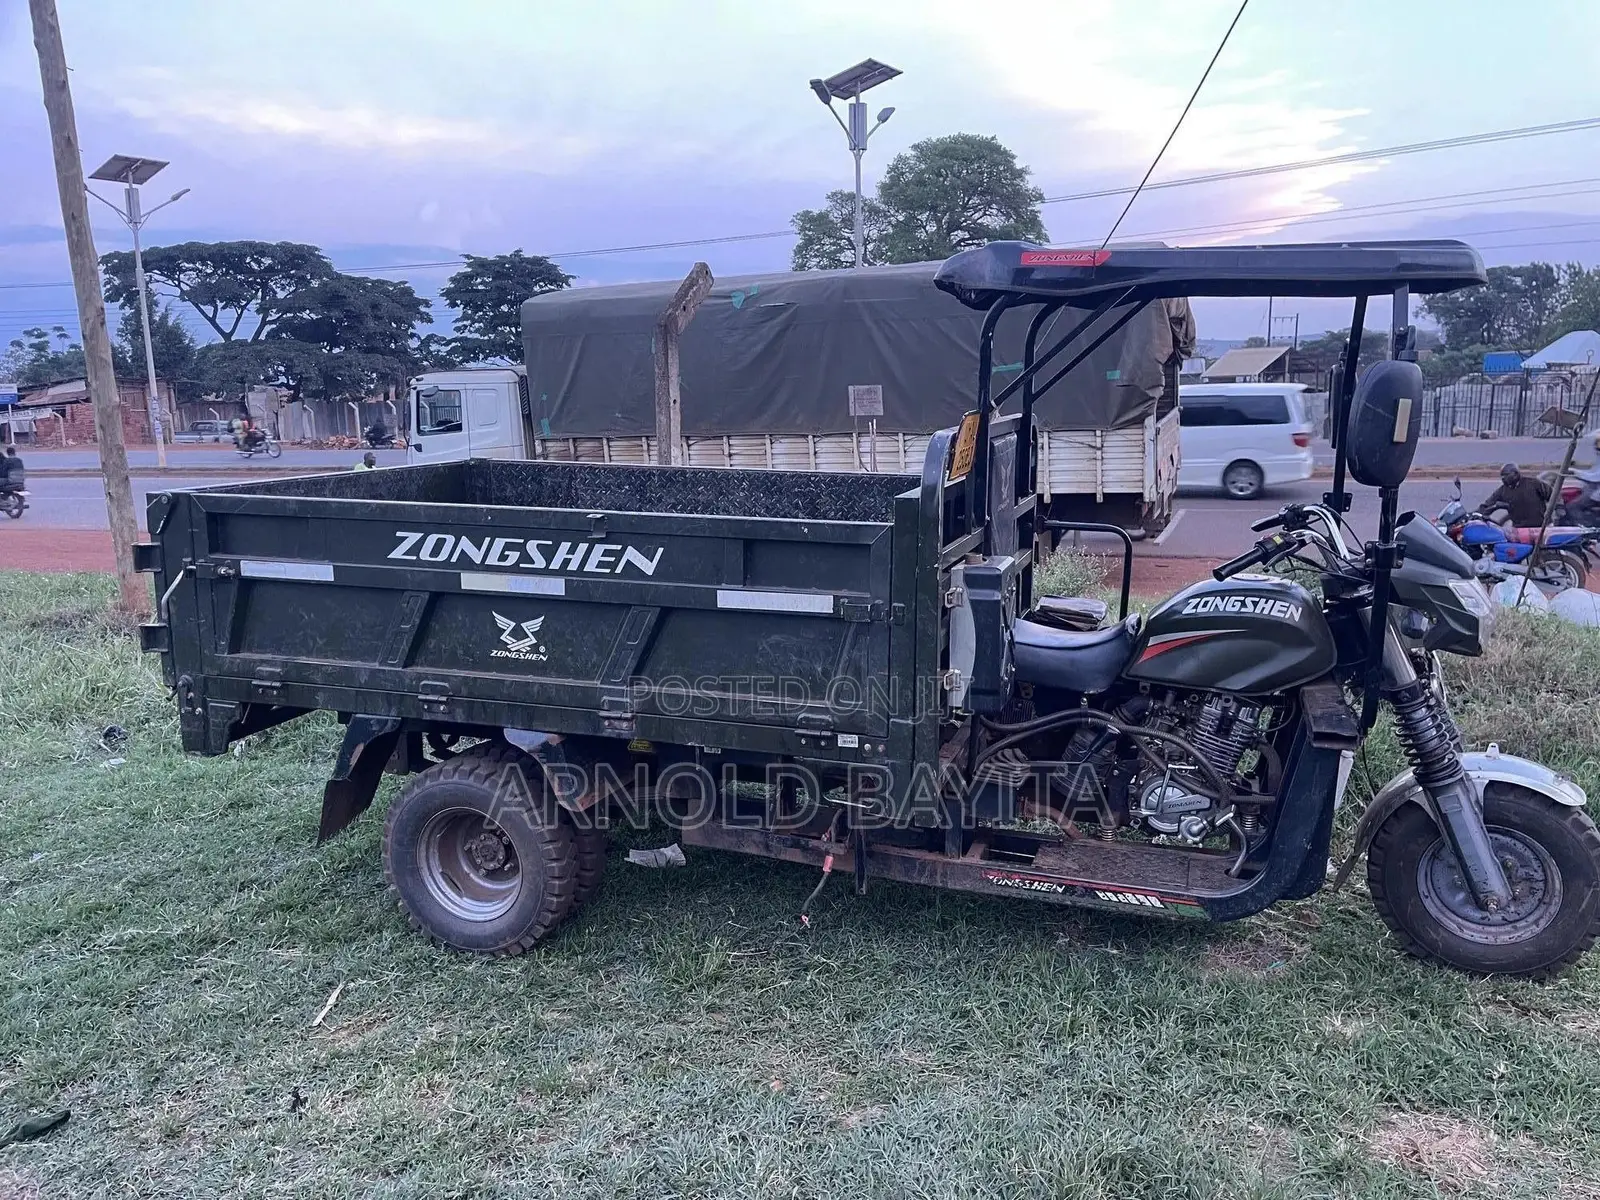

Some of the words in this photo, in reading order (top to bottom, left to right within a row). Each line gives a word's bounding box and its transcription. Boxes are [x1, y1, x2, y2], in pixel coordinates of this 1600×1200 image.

[387, 531, 664, 576] ZONGSHEN
[1182, 595, 1302, 622] ZONGSHEN
[490, 649, 548, 662] ZONGSHEN
